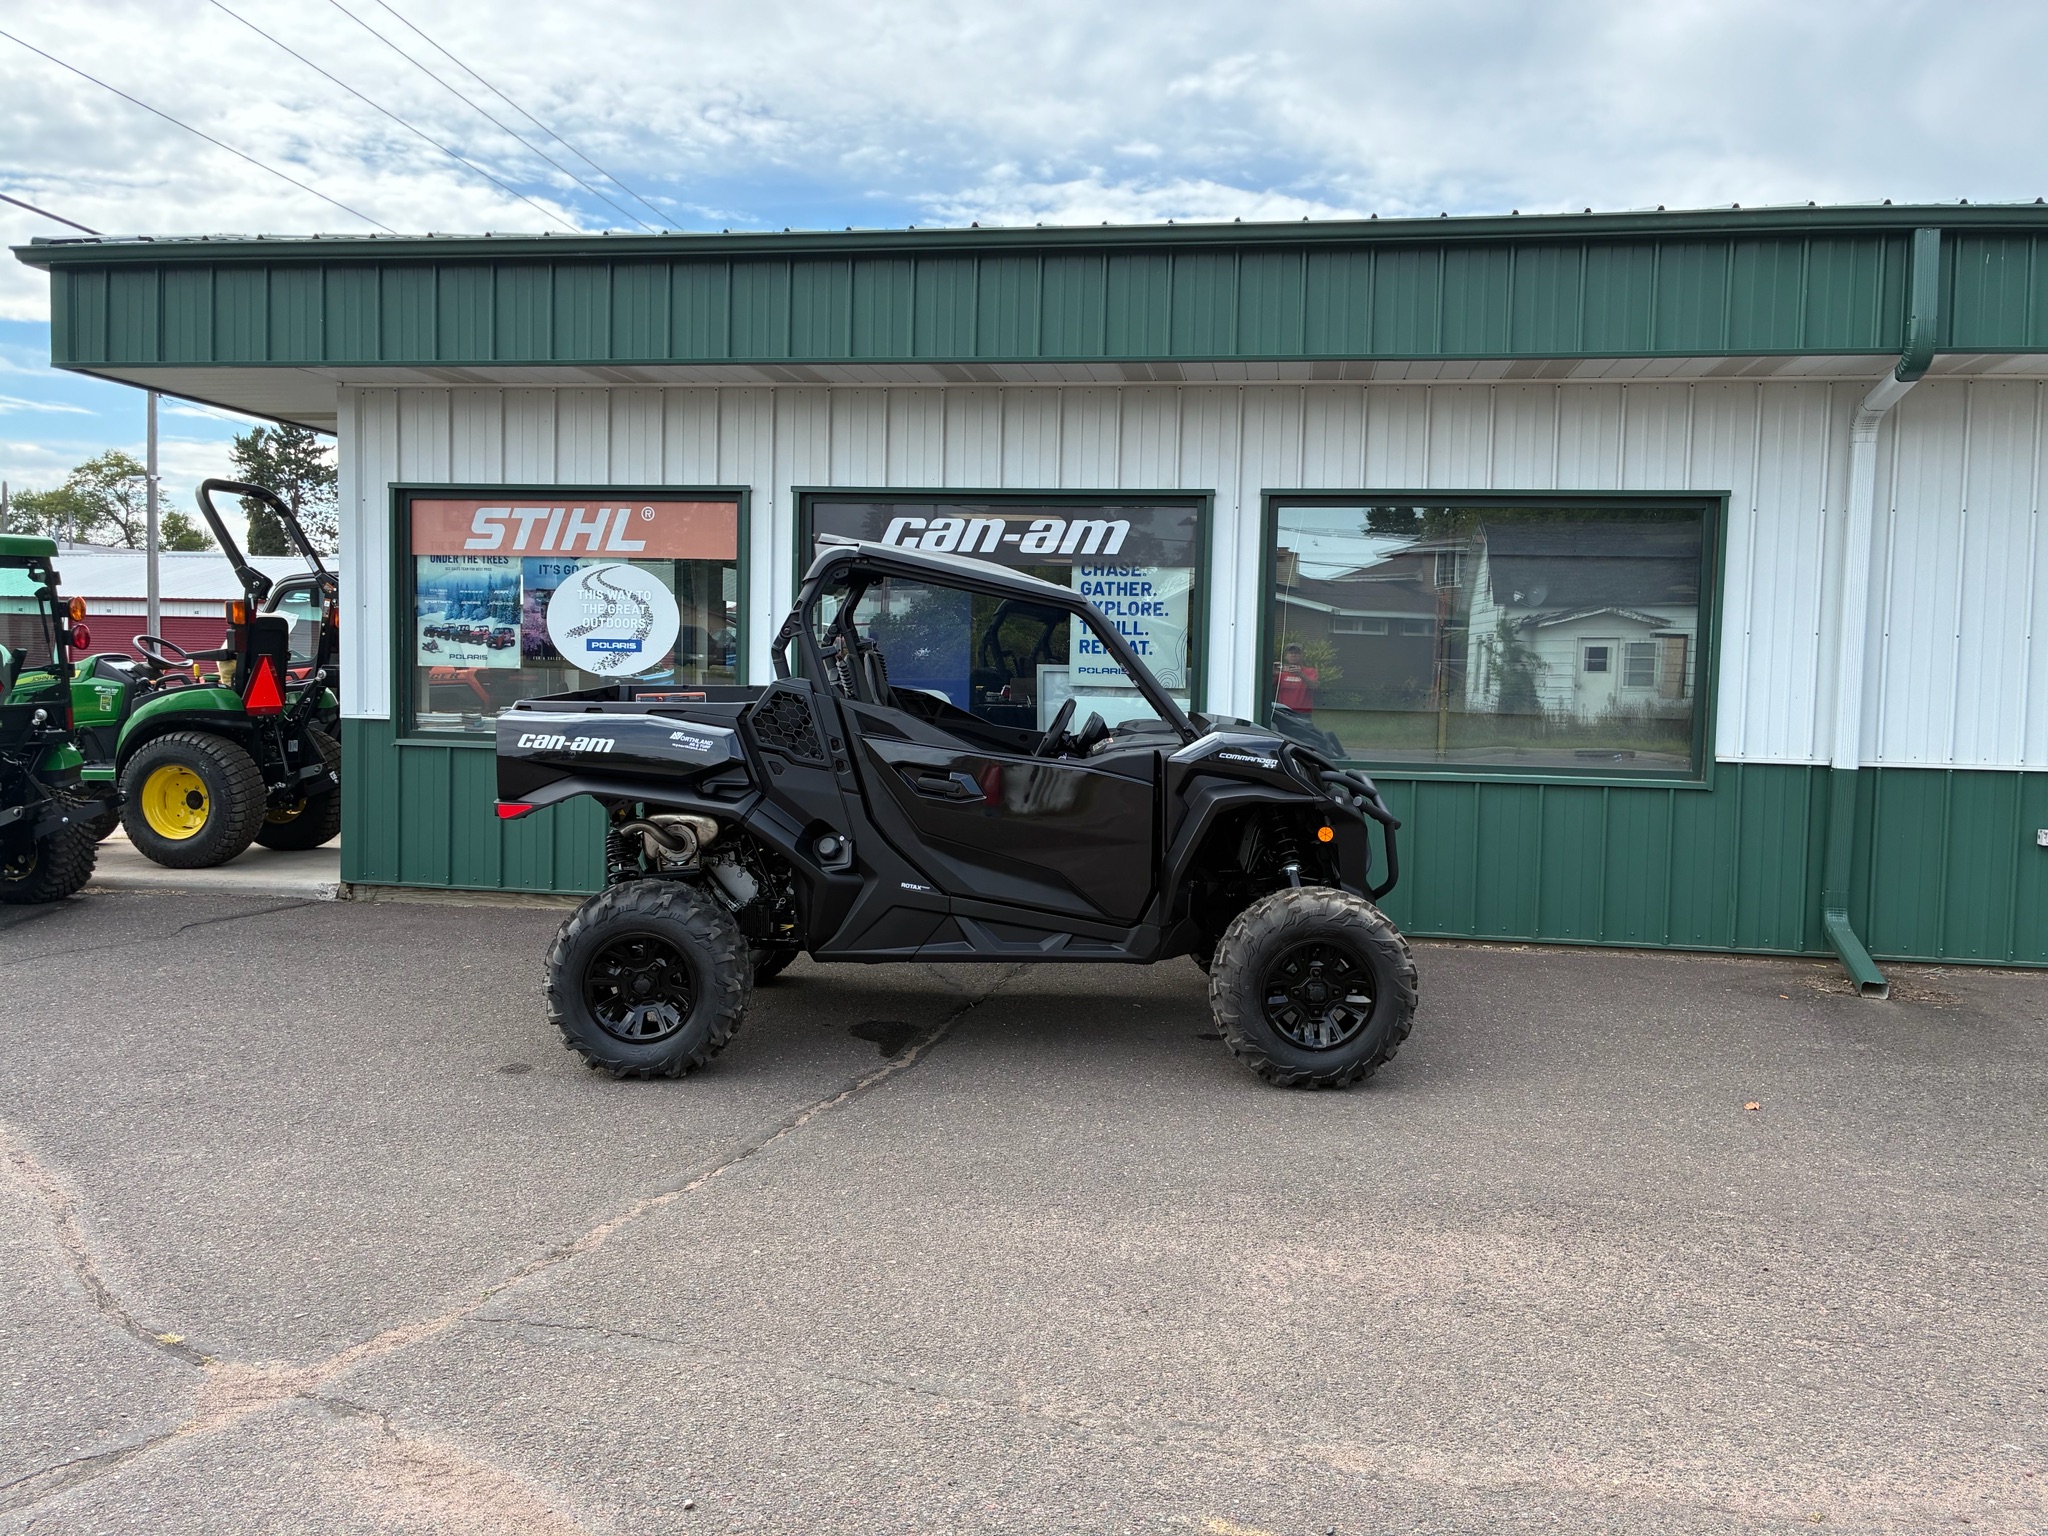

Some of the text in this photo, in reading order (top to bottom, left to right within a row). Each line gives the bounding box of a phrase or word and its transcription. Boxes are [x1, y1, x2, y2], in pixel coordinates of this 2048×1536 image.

[464, 507, 647, 552] STIHL
[881, 517, 1131, 555] can-am
[430, 555, 509, 565] UNDER THE TREES
[538, 564, 561, 575] IT'S
[1081, 561, 1148, 577] CHASE.
[577, 589, 653, 601] THIS WAY TO
[1081, 581, 1158, 597] GATHER.
[582, 603, 647, 615] THE GREAT
[1088, 600, 1169, 617] XPLORE.
[1079, 620, 1150, 636] TILL.
[591, 641, 637, 650] POLARIS
[449, 653, 489, 661] POLARIS
[517, 733, 616, 754] can-am
[669, 731, 714, 747] NORTHLAND
[1218, 752, 1279, 766] COMMANDER
[900, 882, 922, 891] ROTAX
